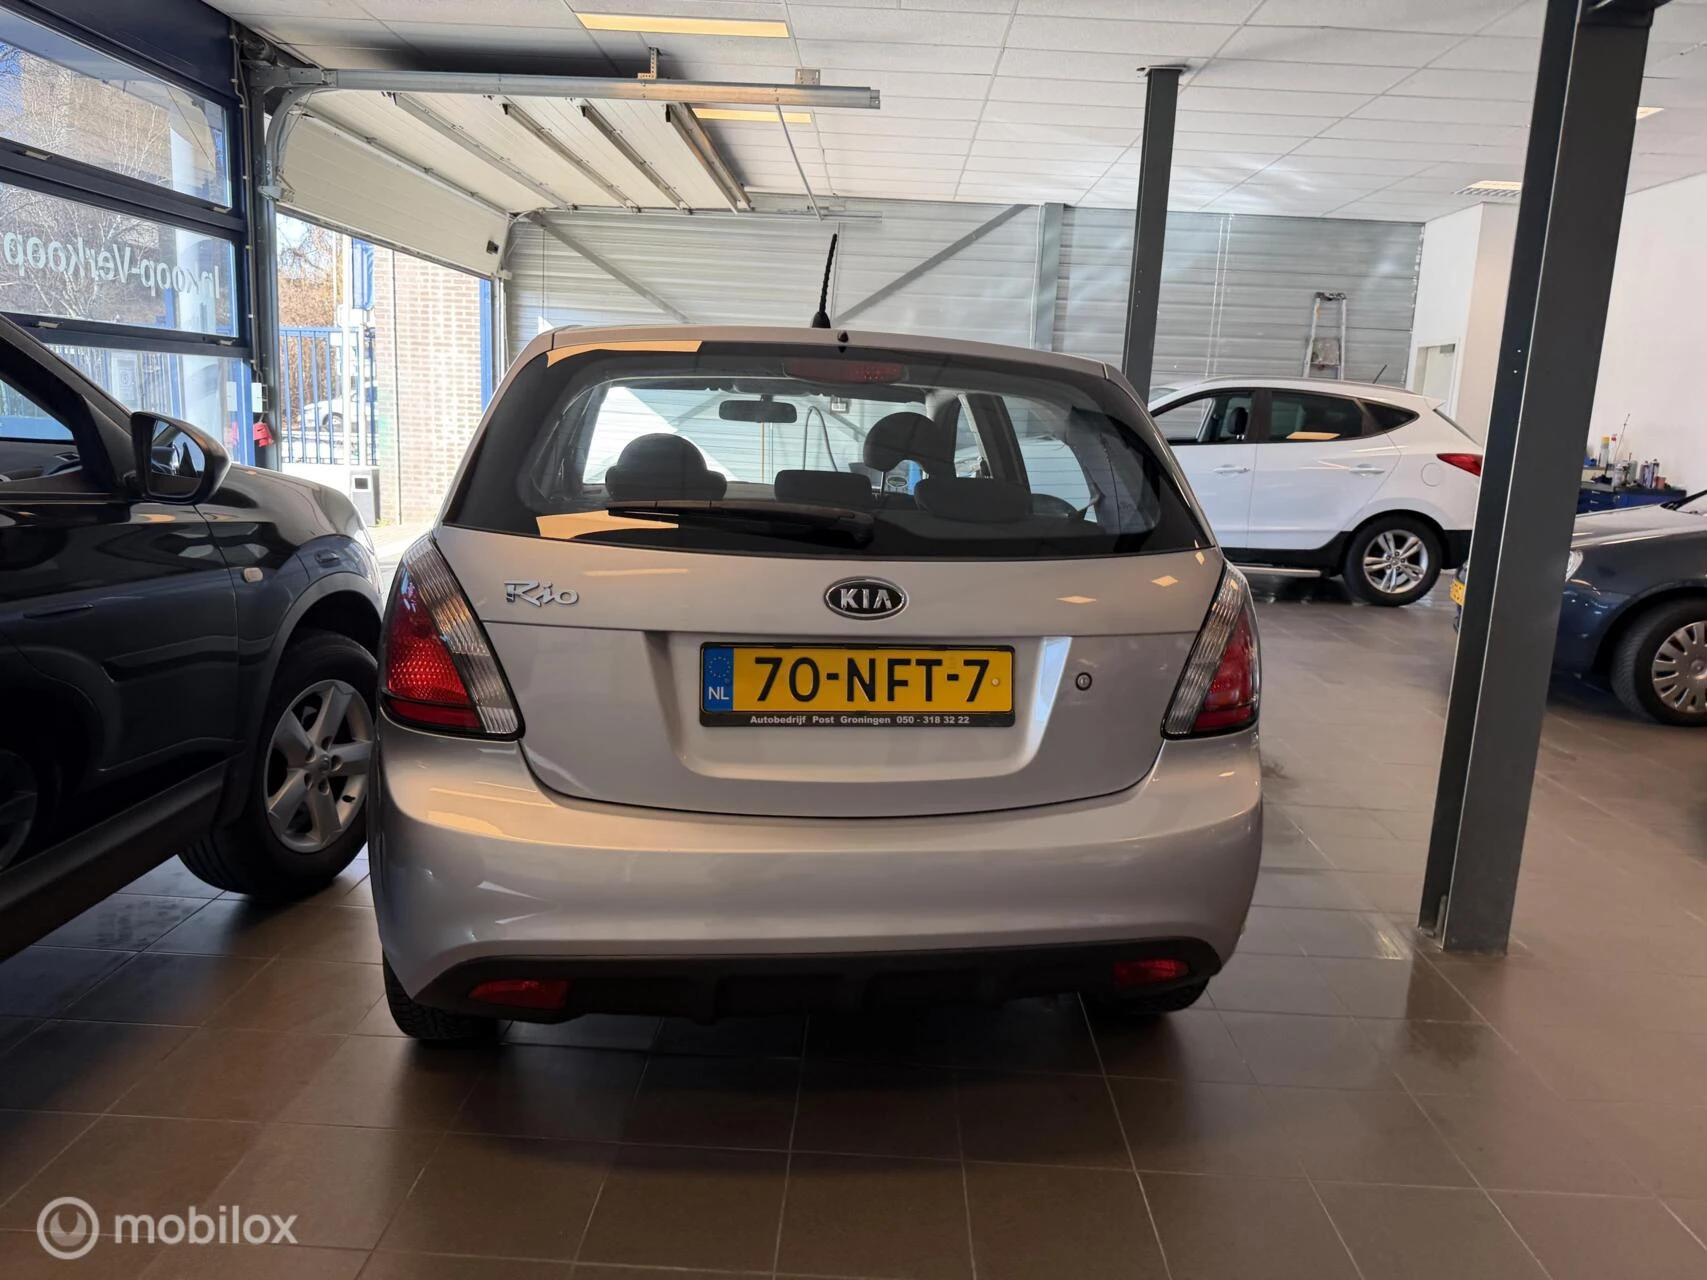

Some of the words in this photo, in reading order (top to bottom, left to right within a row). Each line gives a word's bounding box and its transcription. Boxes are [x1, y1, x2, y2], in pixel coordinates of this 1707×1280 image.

[504, 580, 579, 607] Rio
[840, 588, 893, 610] KIA
[754, 656, 990, 703] 70-NFT-7
[708, 686, 730, 700] NL
[750, 715, 806, 725] Autobedrijf
[812, 715, 835, 724] Post
[840, 715, 891, 725] Groningen
[896, 715, 914, 724] 050
[923, 715, 941, 724] 318
[943, 715, 956, 724] 32
[957, 715, 970, 724] 22
